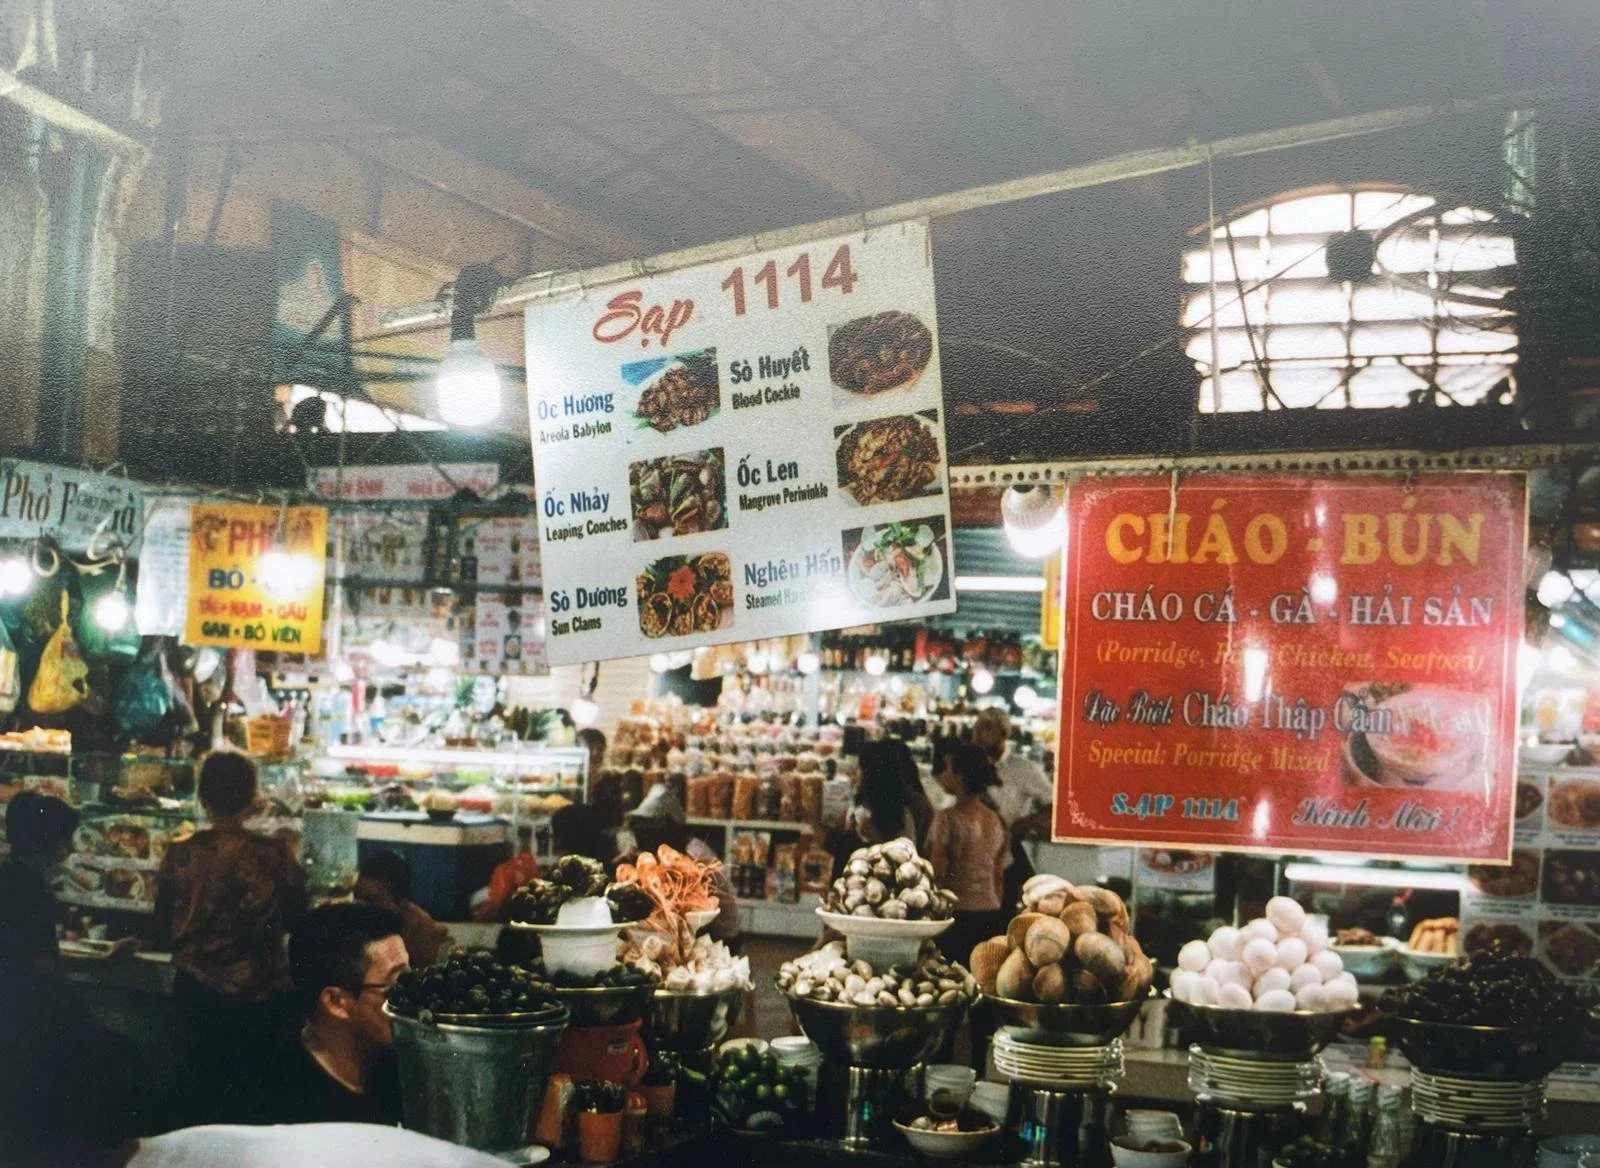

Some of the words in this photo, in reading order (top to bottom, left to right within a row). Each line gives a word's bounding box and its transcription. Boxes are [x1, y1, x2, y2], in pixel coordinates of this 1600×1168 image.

[592, 290, 695, 347] Sạp
[721, 244, 858, 316] 1114
[730, 359, 753, 384] Sò
[758, 346, 811, 379] Huyết
[563, 392, 615, 417] Hương
[732, 389, 763, 410] Blood
[540, 424, 570, 445] Areola
[572, 419, 613, 440] Babylon
[737, 454, 762, 487] Ốc
[766, 459, 799, 483] Len
[544, 487, 566, 518] Ốc
[570, 486, 610, 514] Nhảy
[739, 491, 782, 511] Mangrove
[546, 522, 585, 541] Leaping
[586, 516, 629, 536] Conches
[1105, 498, 1289, 565] CHÁO
[1340, 496, 1487, 567] BÚN
[744, 558, 800, 588] Nghêu
[550, 590, 570, 613] Sò
[576, 585, 629, 609] Dương
[746, 589, 783, 610] Steamed
[1091, 583, 1184, 622] CHÁO
[1193, 584, 1238, 623] CÁ
[1269, 585, 1317, 624] GÀ
[1348, 583, 1414, 626] HẢI
[1423, 583, 1494, 627] SẢN
[551, 619, 570, 636] Sun
[572, 615, 602, 631] Clams
[1096, 639, 1205, 669] (Porridge,
[1183, 691, 1250, 728] Cháo
[1261, 692, 1326, 740] Thập
[1089, 740, 1165, 769] Special:
[1173, 743, 1263, 774] Porridge
[1268, 746, 1332, 772] Mixed
[1181, 796, 1240, 821] 1114
